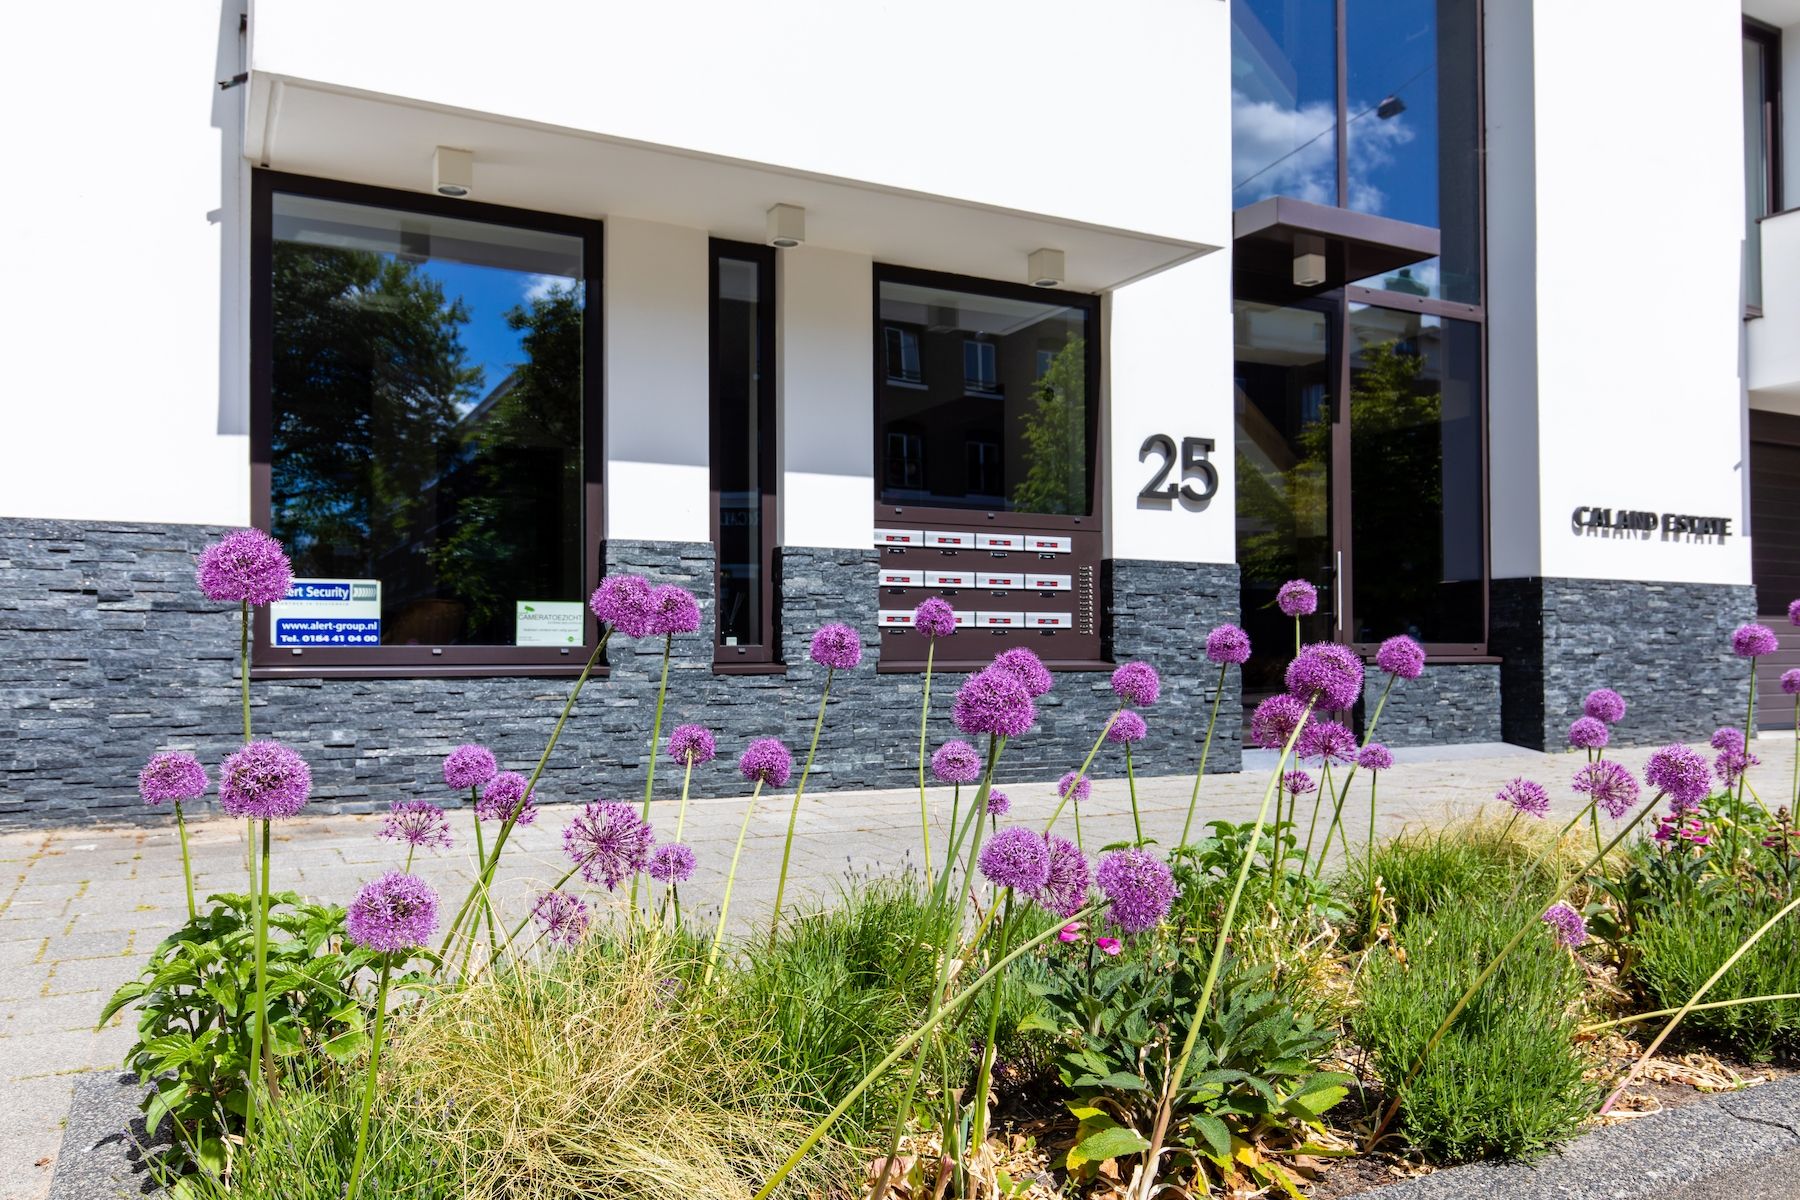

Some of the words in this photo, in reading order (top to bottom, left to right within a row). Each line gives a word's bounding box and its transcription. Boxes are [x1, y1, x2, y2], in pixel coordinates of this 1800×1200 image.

[1138, 433, 1219, 502] 25
[1572, 506, 1658, 531] CALAND
[1661, 513, 1732, 536] ESTATE
[306, 585, 349, 599] Security
[281, 621, 377, 632] www.alert-group.nl
[280, 634, 300, 642] Tel.
[302, 634, 330, 642] 0184
[331, 634, 345, 642] 41
[347, 634, 362, 642] 04
[363, 634, 378, 642] 00
